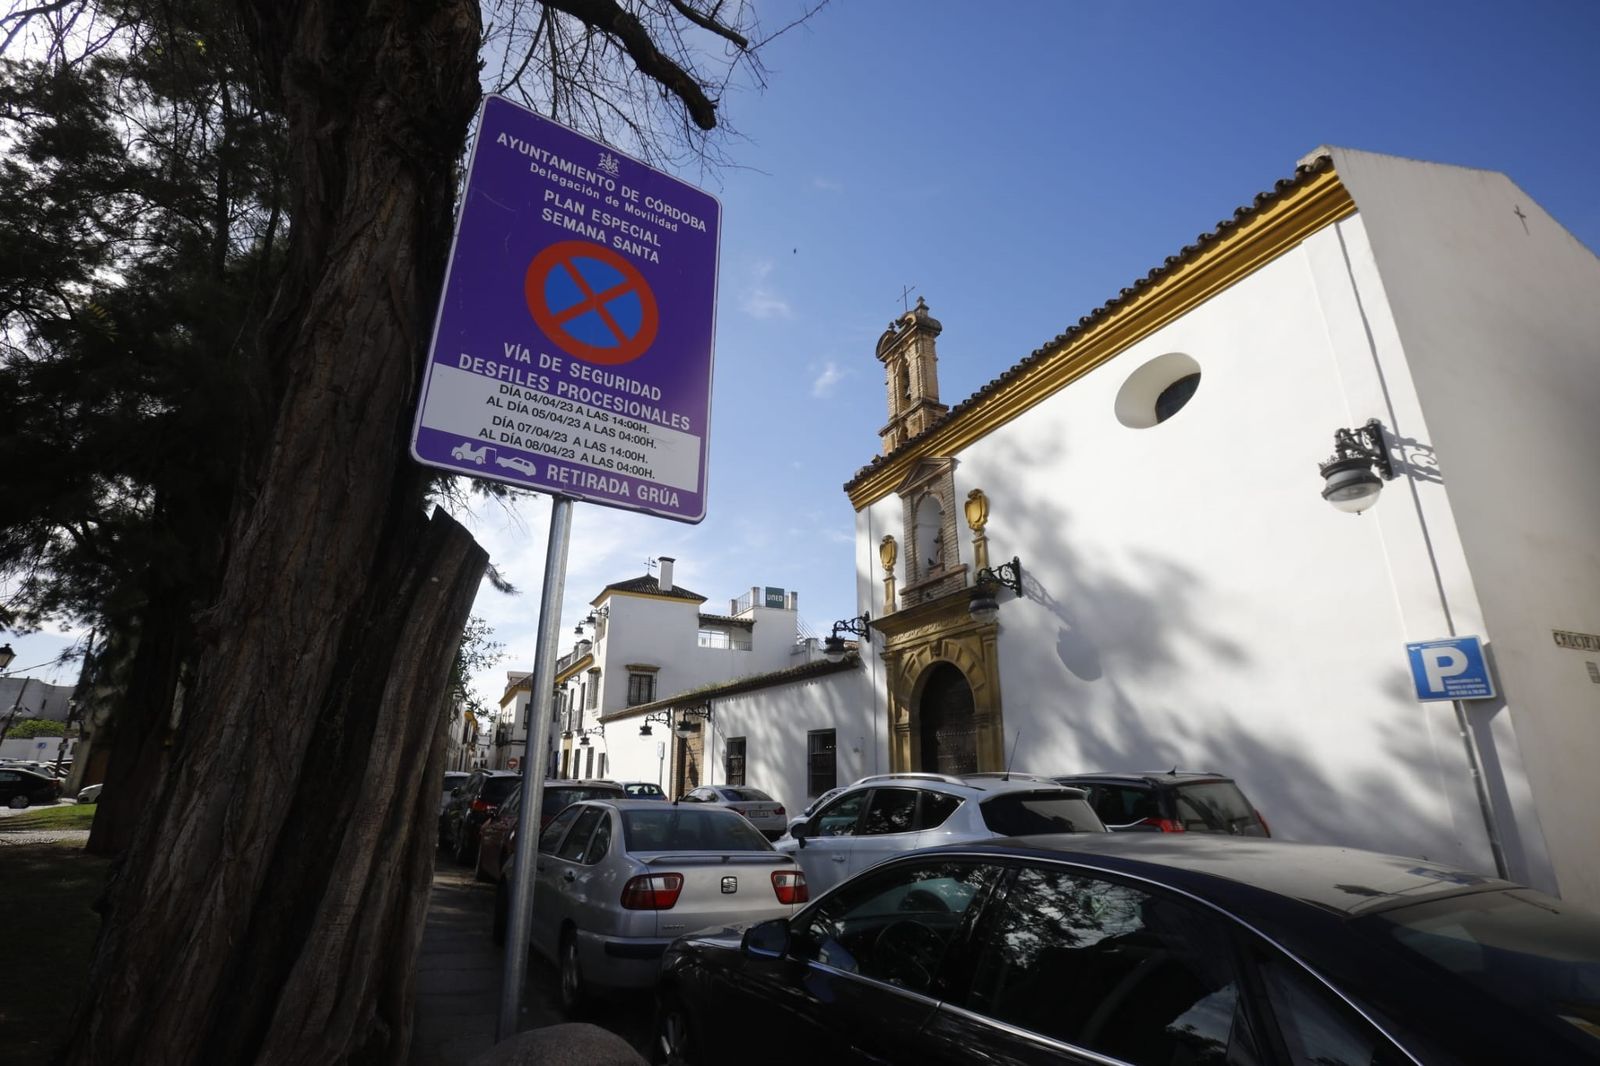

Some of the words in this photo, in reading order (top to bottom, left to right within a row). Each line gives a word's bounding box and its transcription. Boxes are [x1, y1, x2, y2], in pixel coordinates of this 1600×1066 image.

[497, 132, 616, 192] AYUNTAMIENTO
[621, 185, 640, 203] DE
[645, 195, 707, 232] CÓRDOBA
[530, 162, 600, 200] Delegación
[605, 194, 620, 208] de
[624, 203, 678, 232] Movilidad
[541, 208, 606, 244] SEMANA
[612, 235, 660, 264] SANTA
[543, 189, 585, 216] PLAN
[591, 208, 662, 247] ESPECIAL
[458, 353, 550, 392] DESFILES
[557, 380, 690, 430] PROCESIONALES
[503, 342, 531, 364] VÍA
[539, 354, 563, 373] DE
[569, 362, 662, 401] SEGURIDAD
[486, 395, 503, 409] AL
[507, 401, 529, 416] DÍA
[531, 407, 581, 429] 05/04/23
[582, 421, 593, 432] A
[594, 424, 616, 438] LAS
[618, 431, 657, 449] 04:00H.
[499, 384, 522, 399] DÍA
[524, 391, 574, 413] 04/04/23
[575, 405, 584, 416] A
[586, 408, 609, 422] LAS
[612, 416, 650, 434] 14:00H.
[478, 427, 498, 441] AL
[500, 431, 523, 447] DÍA
[525, 438, 575, 459] 08/04/23
[580, 453, 589, 463] A
[591, 454, 614, 469] LAS
[616, 461, 655, 480] 04:00H.
[492, 415, 515, 431] DÍA
[517, 421, 568, 443] 07/04/23
[572, 436, 582, 447] A
[584, 439, 607, 453] LAS
[610, 445, 648, 464] 14:00H.
[547, 463, 631, 497] RETIRADA
[637, 484, 680, 508] GRÚA
[1420, 646, 1469, 693] P
